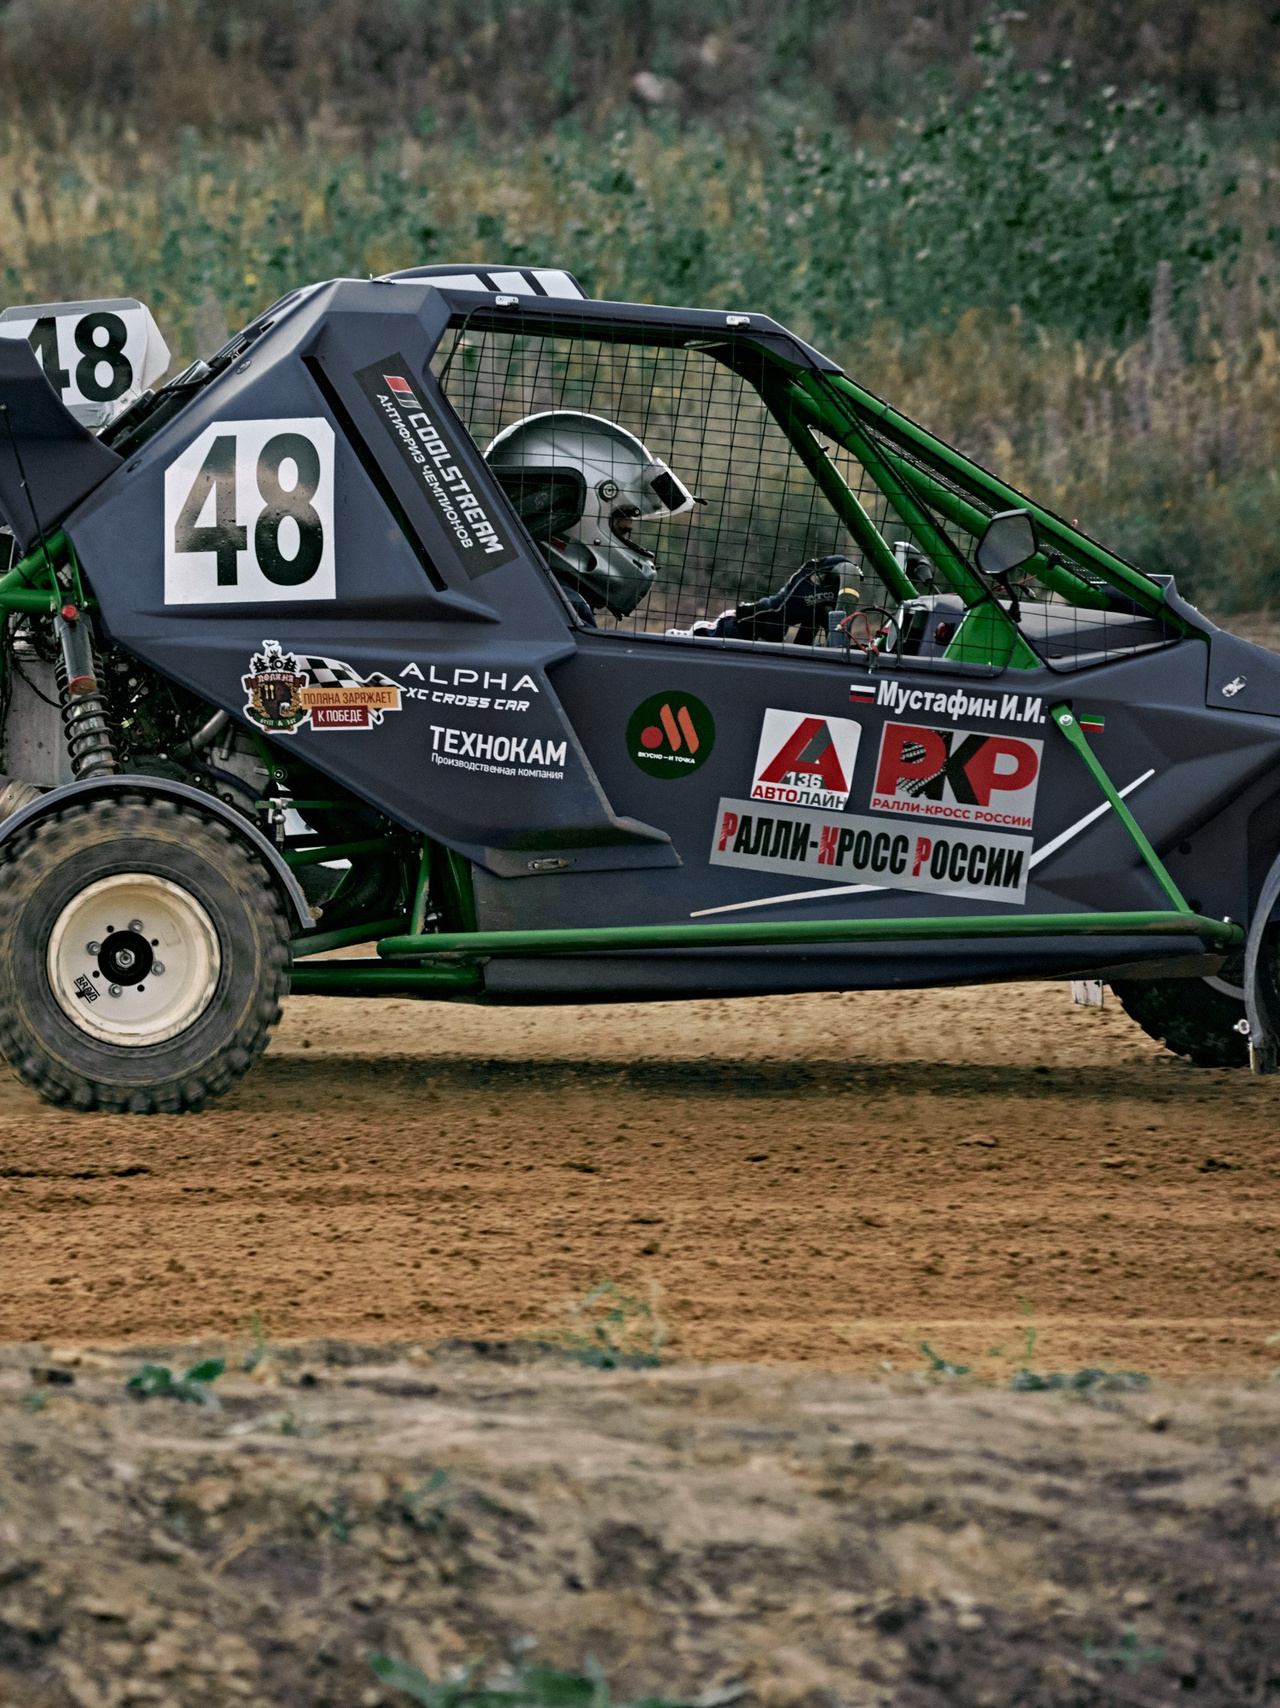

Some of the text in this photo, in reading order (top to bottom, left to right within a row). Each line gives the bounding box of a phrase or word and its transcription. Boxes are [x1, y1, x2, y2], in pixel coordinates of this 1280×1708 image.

[27, 312, 133, 402] 48
[376, 394, 474, 549] АНТИФРИЗ ЧЕМПИОНОВ
[408, 412, 504, 554] COOLSTREAM
[174, 432, 324, 587] 48
[399, 662, 539, 693] ALPHA
[303, 692, 392, 704] ПОЛЯНА ЗАРЯЖАЕТ
[406, 687, 530, 712] XC CROSS CAR
[877, 680, 1046, 724] Мустафин И.И.
[318, 709, 363, 722] К ПОБЕДЕ
[430, 725, 567, 767] ТЕХНОКАМ
[638, 751, 662, 759] ВКУСНО
[675, 756, 695, 764] ТОЧКА
[431, 752, 563, 780] Производственная компания
[786, 771, 822, 789] 136
[751, 785, 847, 809] АВТОЛАЙН
[872, 798, 1031, 828] РАЛЛИ-КРОСС РОССИИ
[718, 812, 1024, 889] РАЛЛИ-КРОСС РОССИИ
